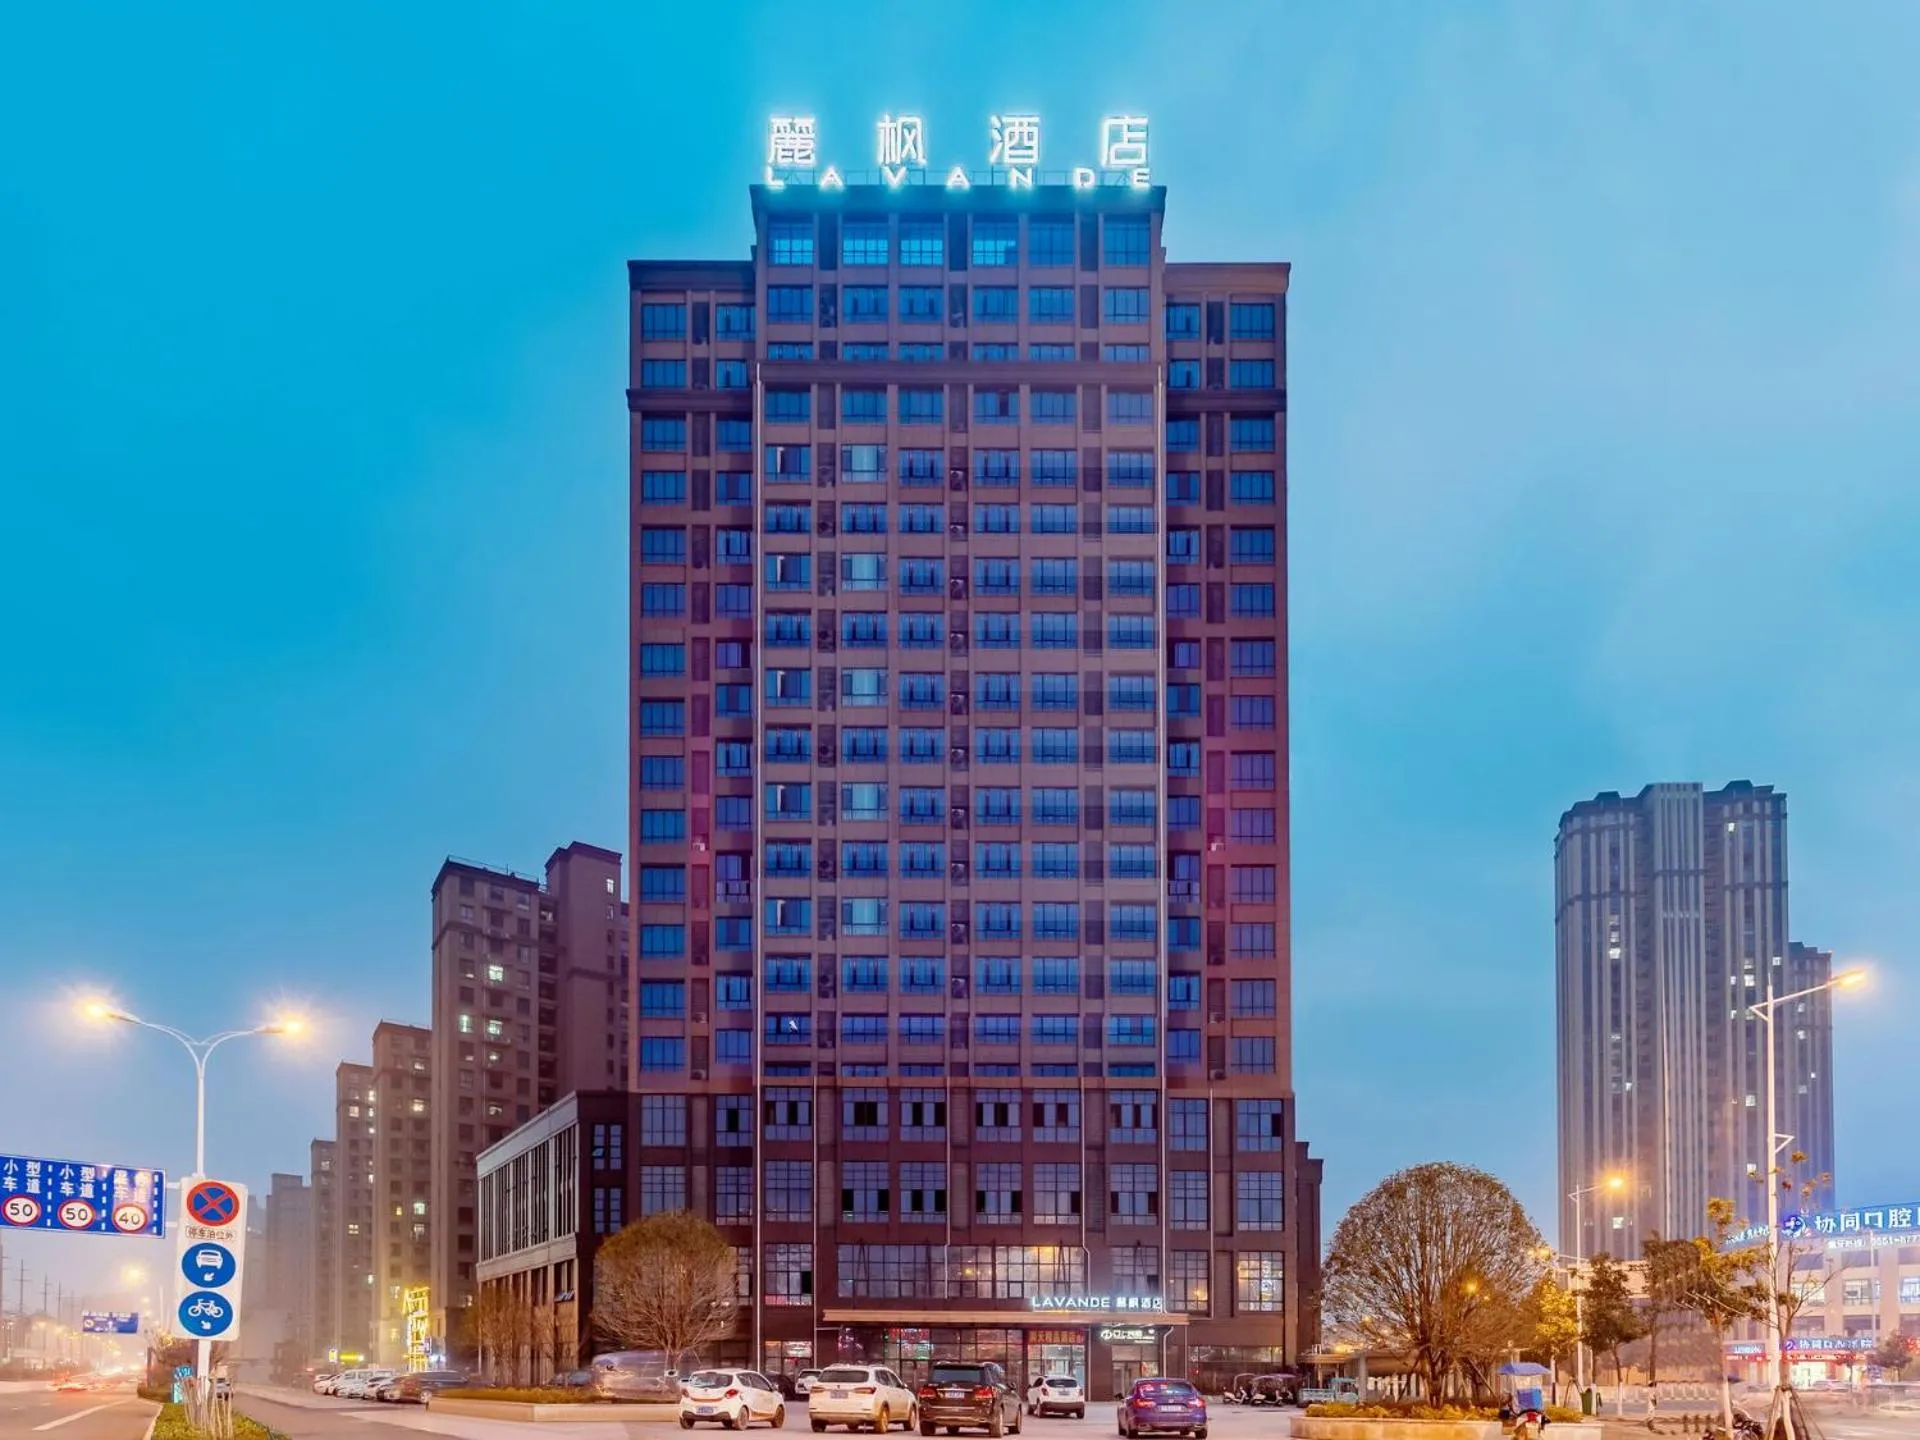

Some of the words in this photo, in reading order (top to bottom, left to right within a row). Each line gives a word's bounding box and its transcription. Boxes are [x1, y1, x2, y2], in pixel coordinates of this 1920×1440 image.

[766, 166, 1152, 189] LAVANDE
[3, 1159, 41, 1177] 小型
[59, 1164, 96, 1183] 小型
[2, 1176, 41, 1194] 车道
[60, 1182, 95, 1199] 车道
[9, 1202, 33, 1217] 50
[65, 1207, 88, 1221] 50
[118, 1211, 141, 1226] 40
[1814, 1207, 1920, 1233] 协同口腔
[1032, 1296, 1111, 1308] LAVANDE
